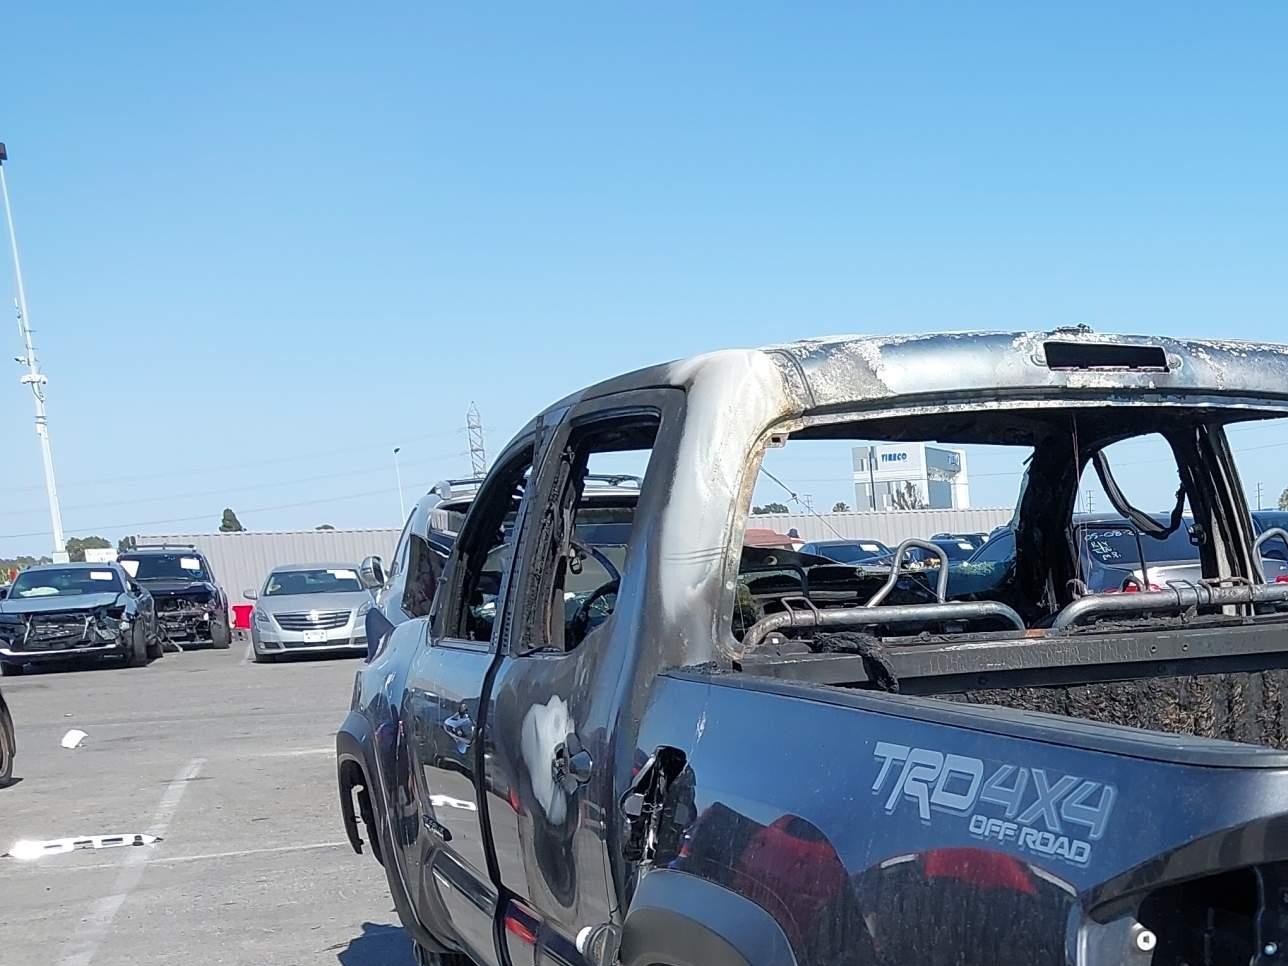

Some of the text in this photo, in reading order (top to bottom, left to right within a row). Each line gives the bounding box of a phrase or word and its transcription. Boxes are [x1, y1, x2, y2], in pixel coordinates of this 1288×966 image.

[872, 741, 984, 821] TRD
[968, 814, 1092, 865] OFF ROAD
